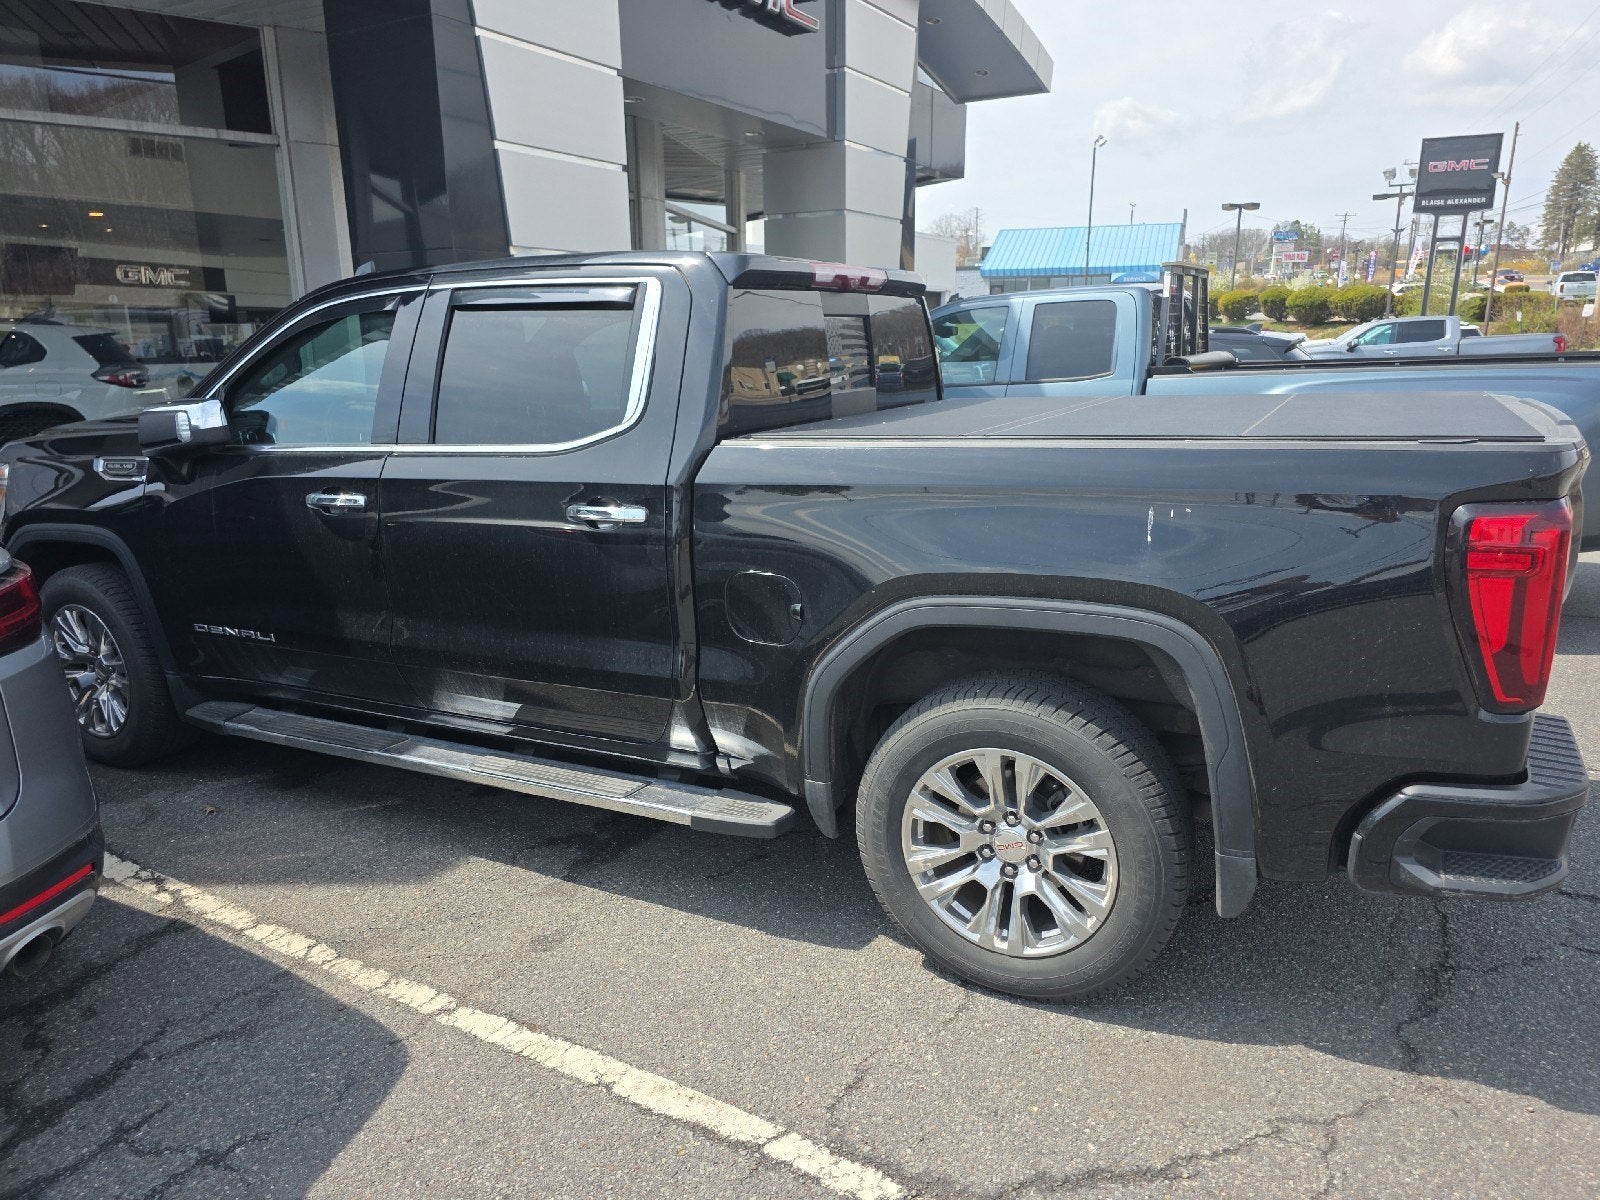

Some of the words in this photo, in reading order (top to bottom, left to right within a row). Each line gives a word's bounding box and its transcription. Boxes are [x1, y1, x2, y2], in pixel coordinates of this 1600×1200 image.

[1428, 158, 1489, 172] GMC
[1446, 197, 1486, 205] ALEXANDER
[115, 264, 191, 286] GMC
[193, 623, 275, 642] DENALI
[997, 842, 1023, 850] GMC
